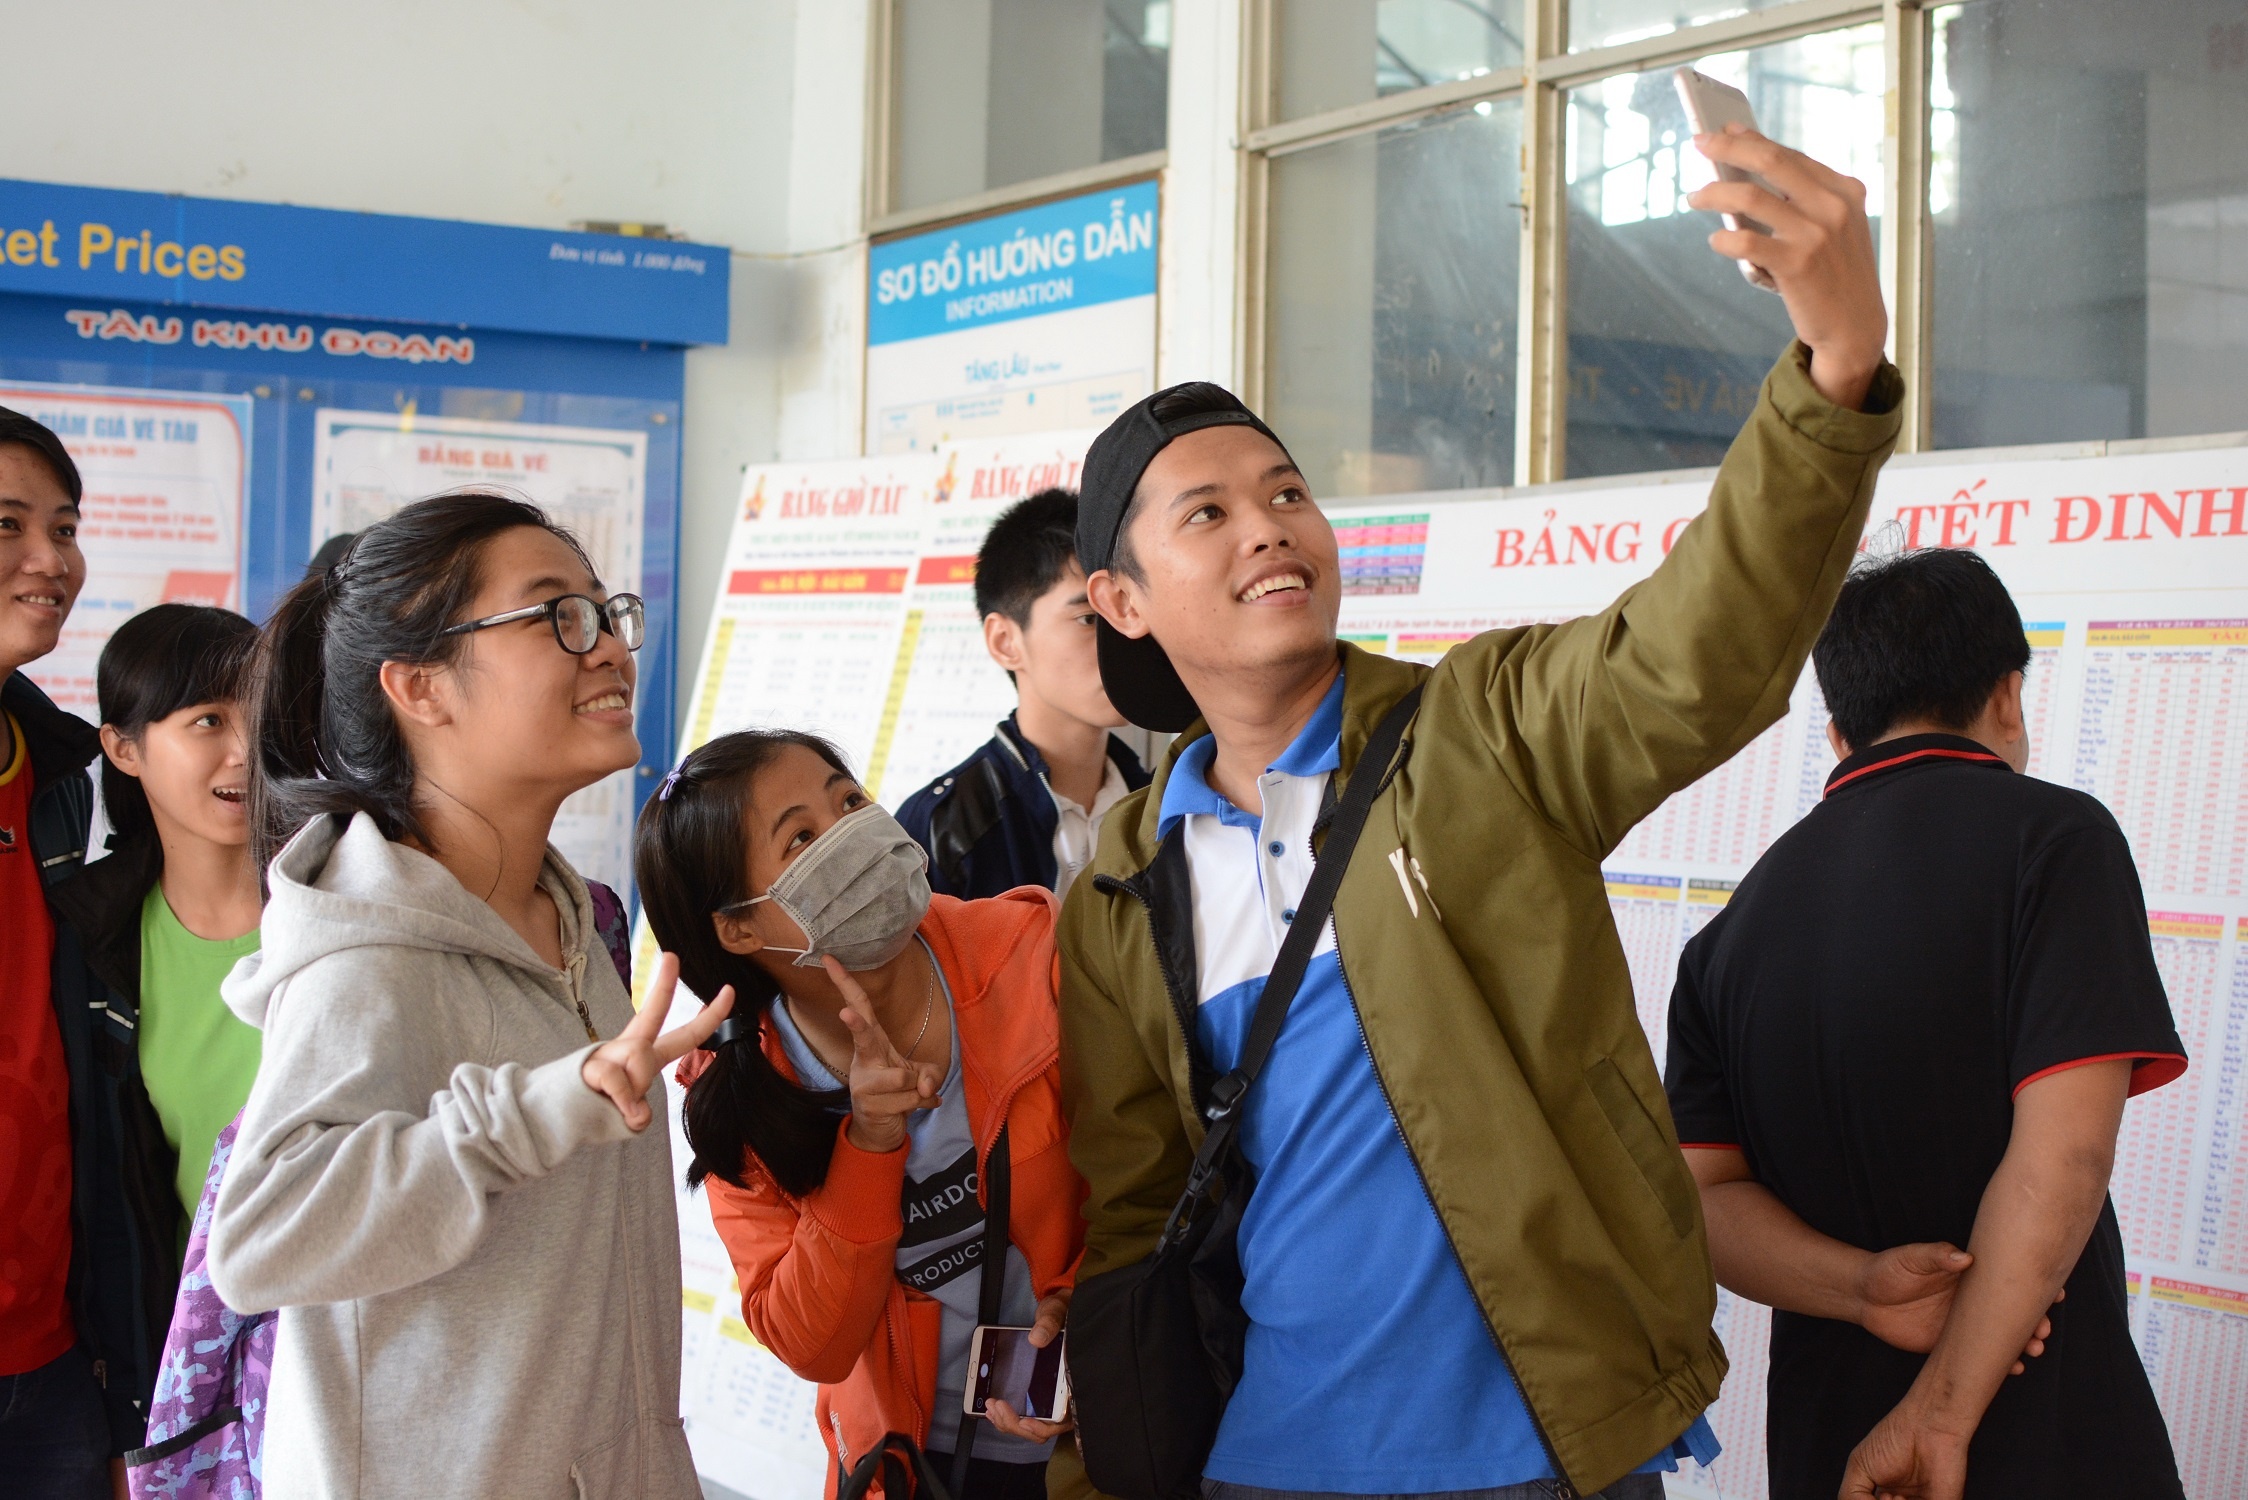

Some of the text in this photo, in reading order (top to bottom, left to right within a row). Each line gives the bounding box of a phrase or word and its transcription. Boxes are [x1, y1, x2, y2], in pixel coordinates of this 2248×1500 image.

[0, 219, 247, 282] et Prices
[877, 197, 1153, 305] SƠ ĐỒ HƯỚNG DẪN
[945, 277, 1074, 323] INFORMATION
[192, 319, 314, 353] KHU
[321, 328, 474, 365] ĐOẠN
[1490, 508, 1643, 569] BẢNG
[1896, 478, 2248, 552] TẾT ĐINH
[901, 1172, 978, 1223] AIRDO
